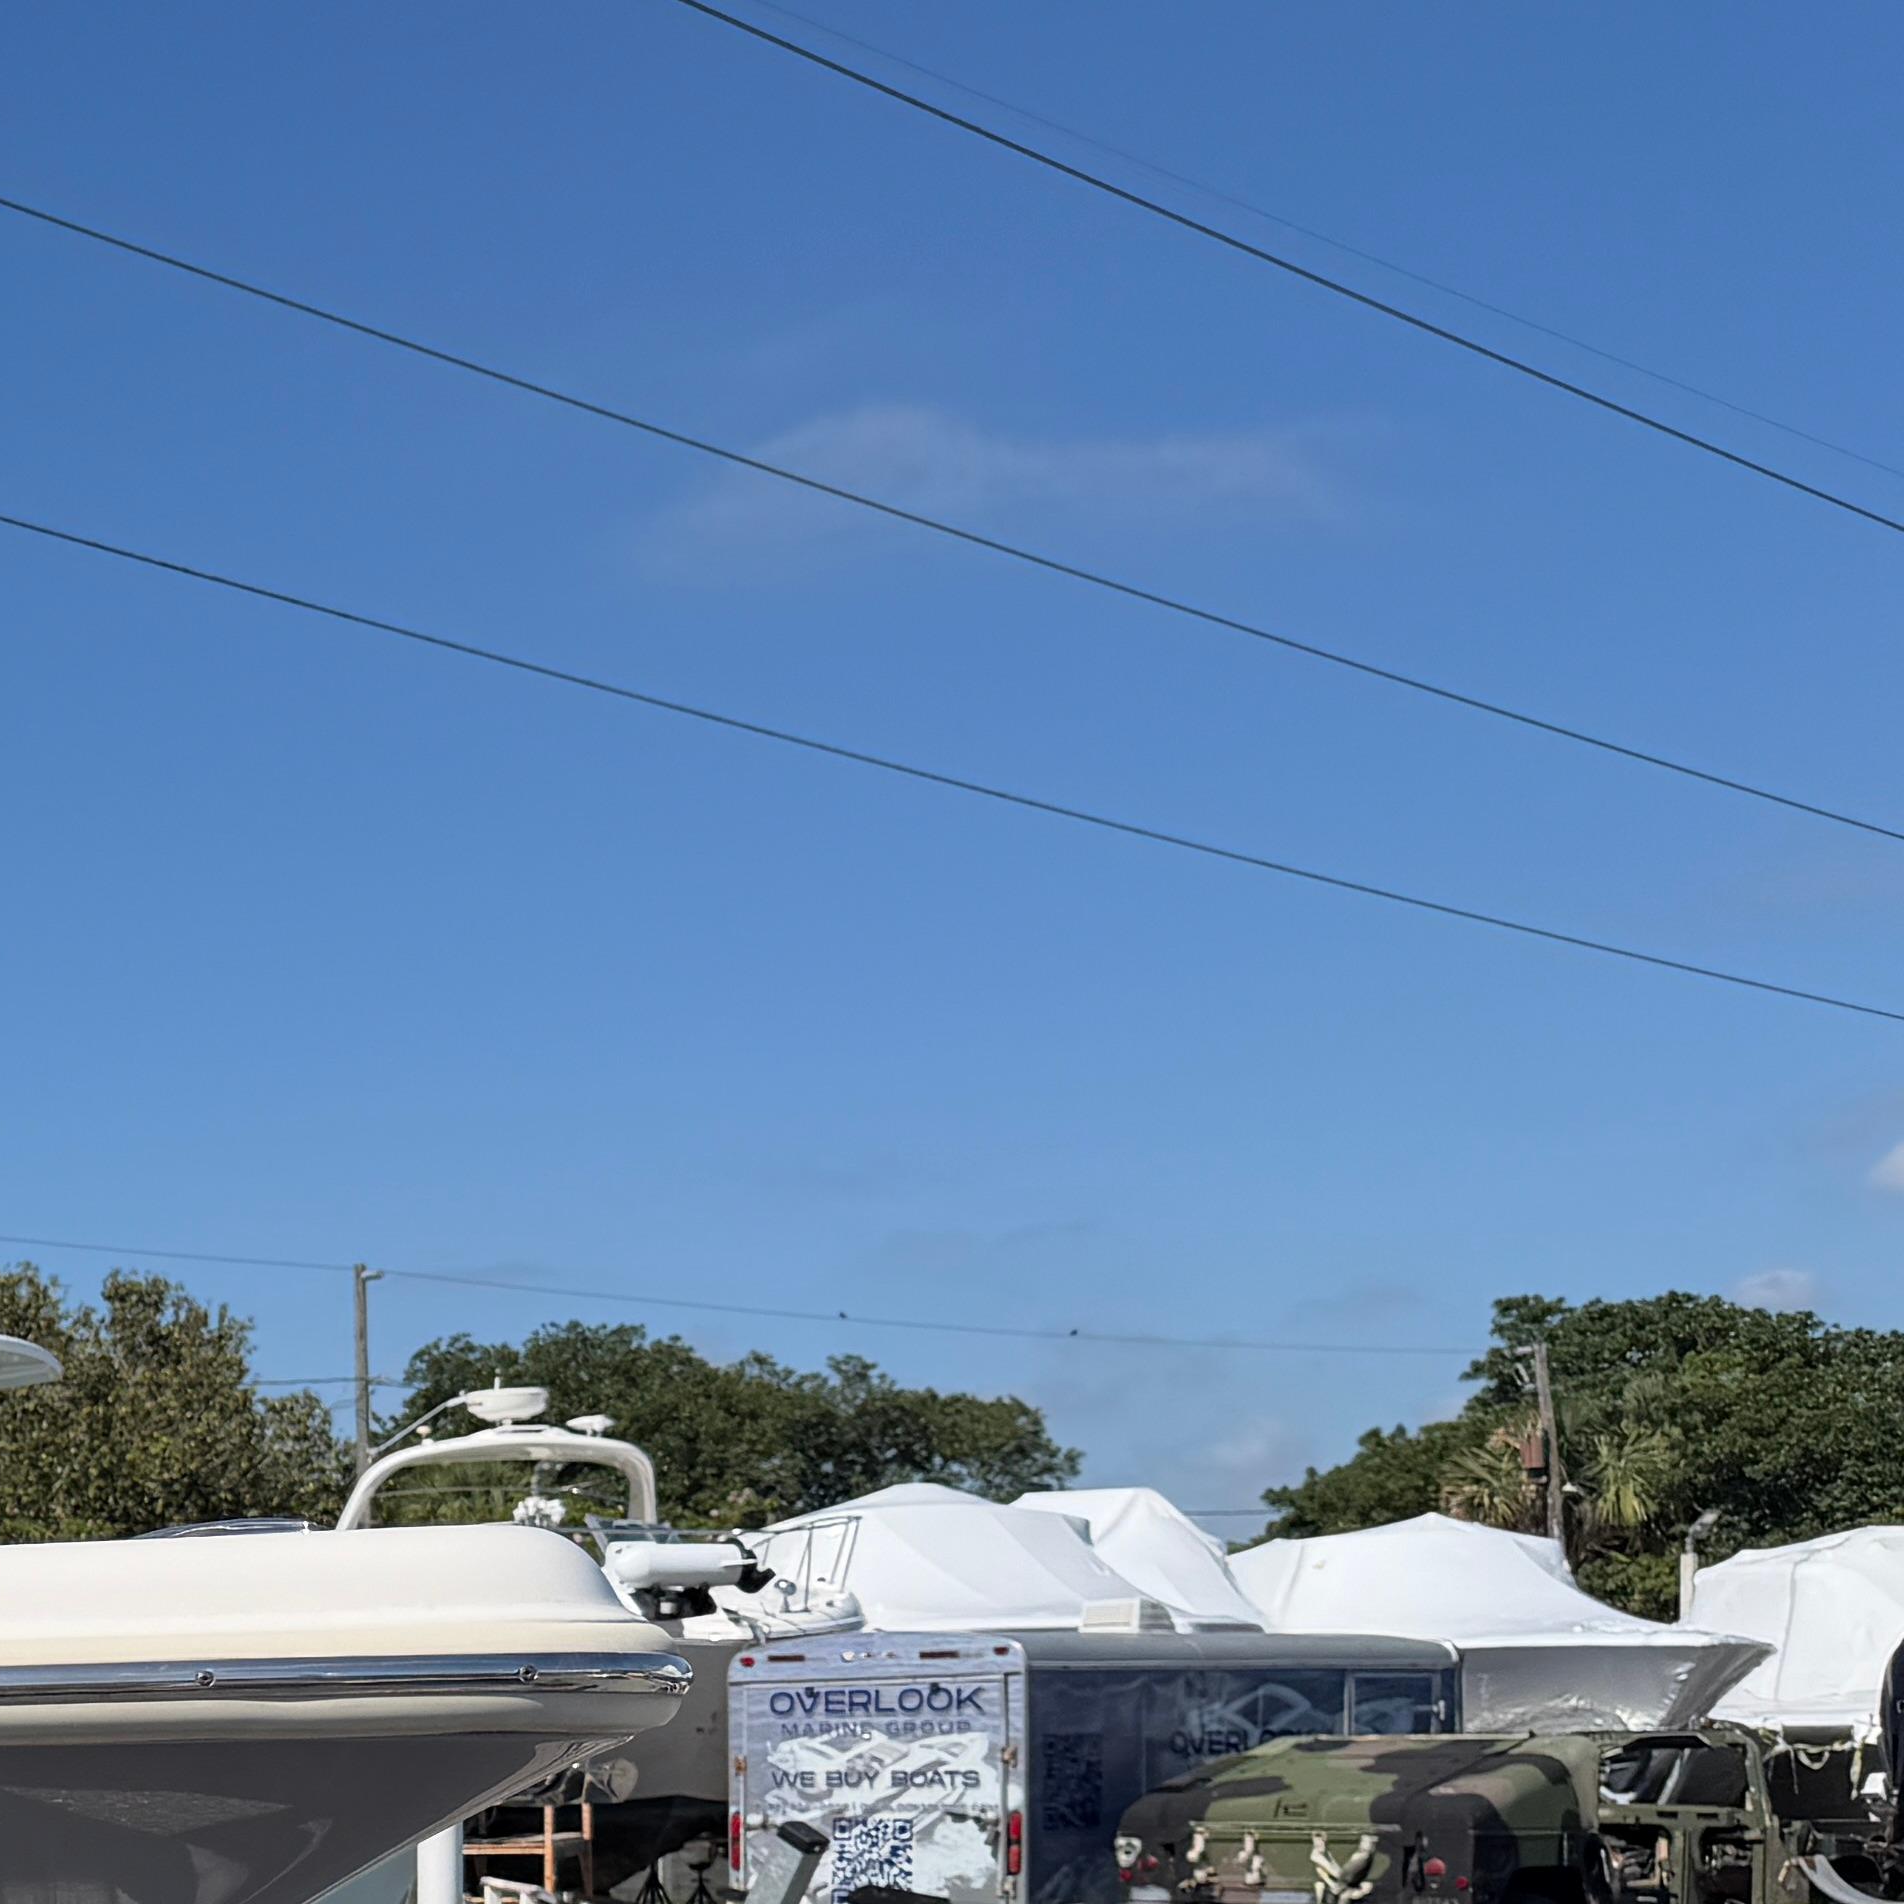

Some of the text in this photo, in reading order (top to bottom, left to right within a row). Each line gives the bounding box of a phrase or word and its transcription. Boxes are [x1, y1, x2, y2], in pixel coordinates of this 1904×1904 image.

[769, 1686, 986, 1717] OVERLOOK
[781, 1719, 971, 1738] MARINE GROUP
[771, 1770, 981, 1789] WE BUY BOATS
